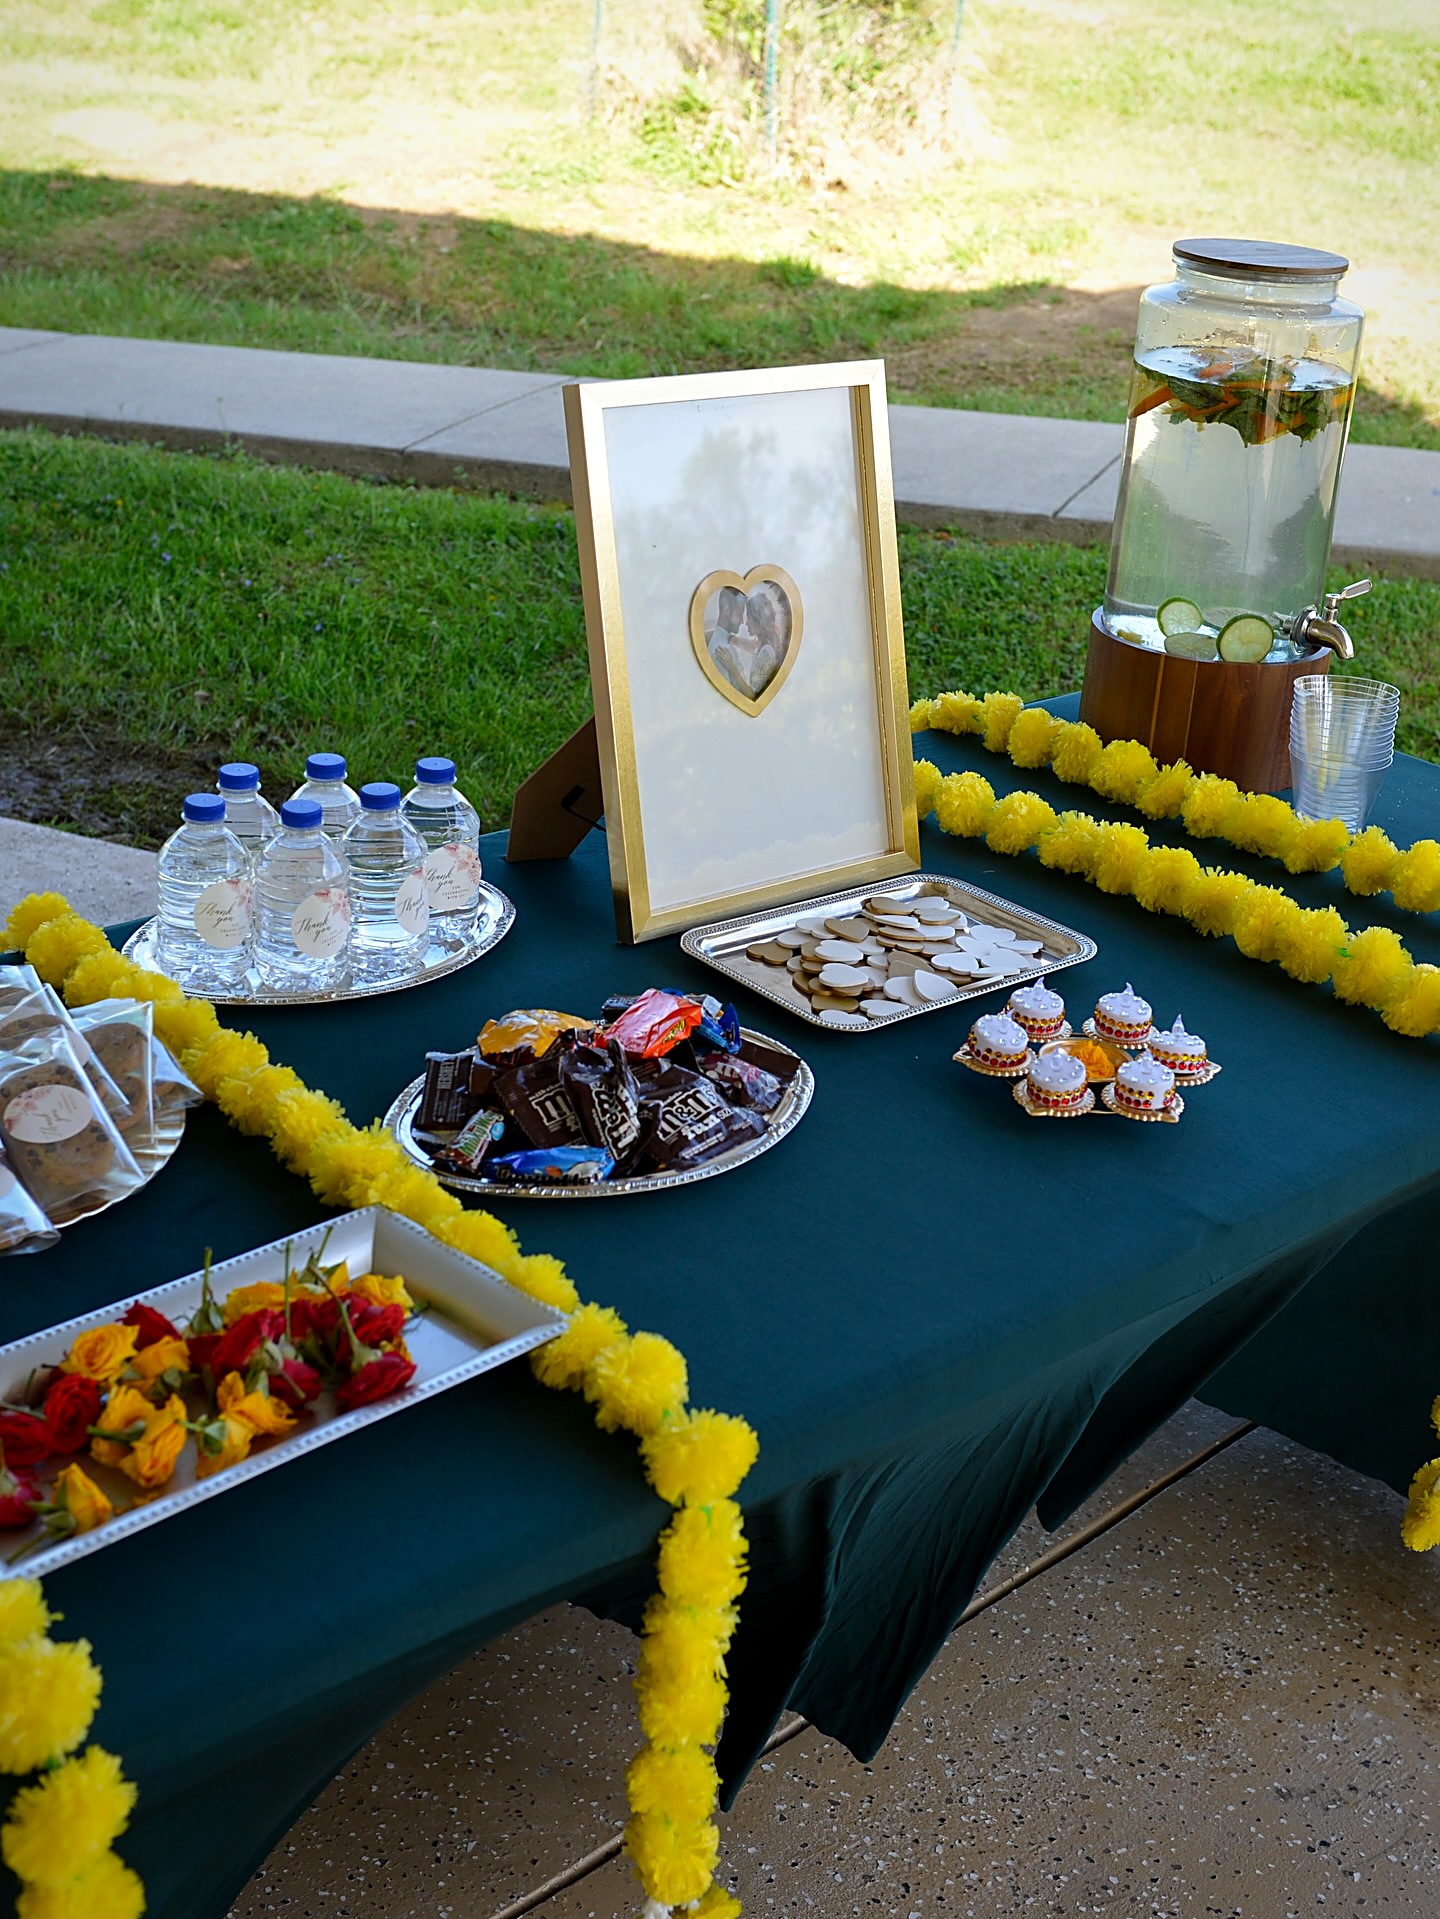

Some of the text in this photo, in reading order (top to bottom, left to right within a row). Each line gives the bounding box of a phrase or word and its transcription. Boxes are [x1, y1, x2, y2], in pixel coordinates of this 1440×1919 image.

[434, 880, 454, 894] you
[197, 897, 238, 916] Thank
[211, 916, 235, 929] you
[294, 905, 331, 936] Thank
[312, 925, 332, 943] you
[681, 1114, 720, 1140] fun
